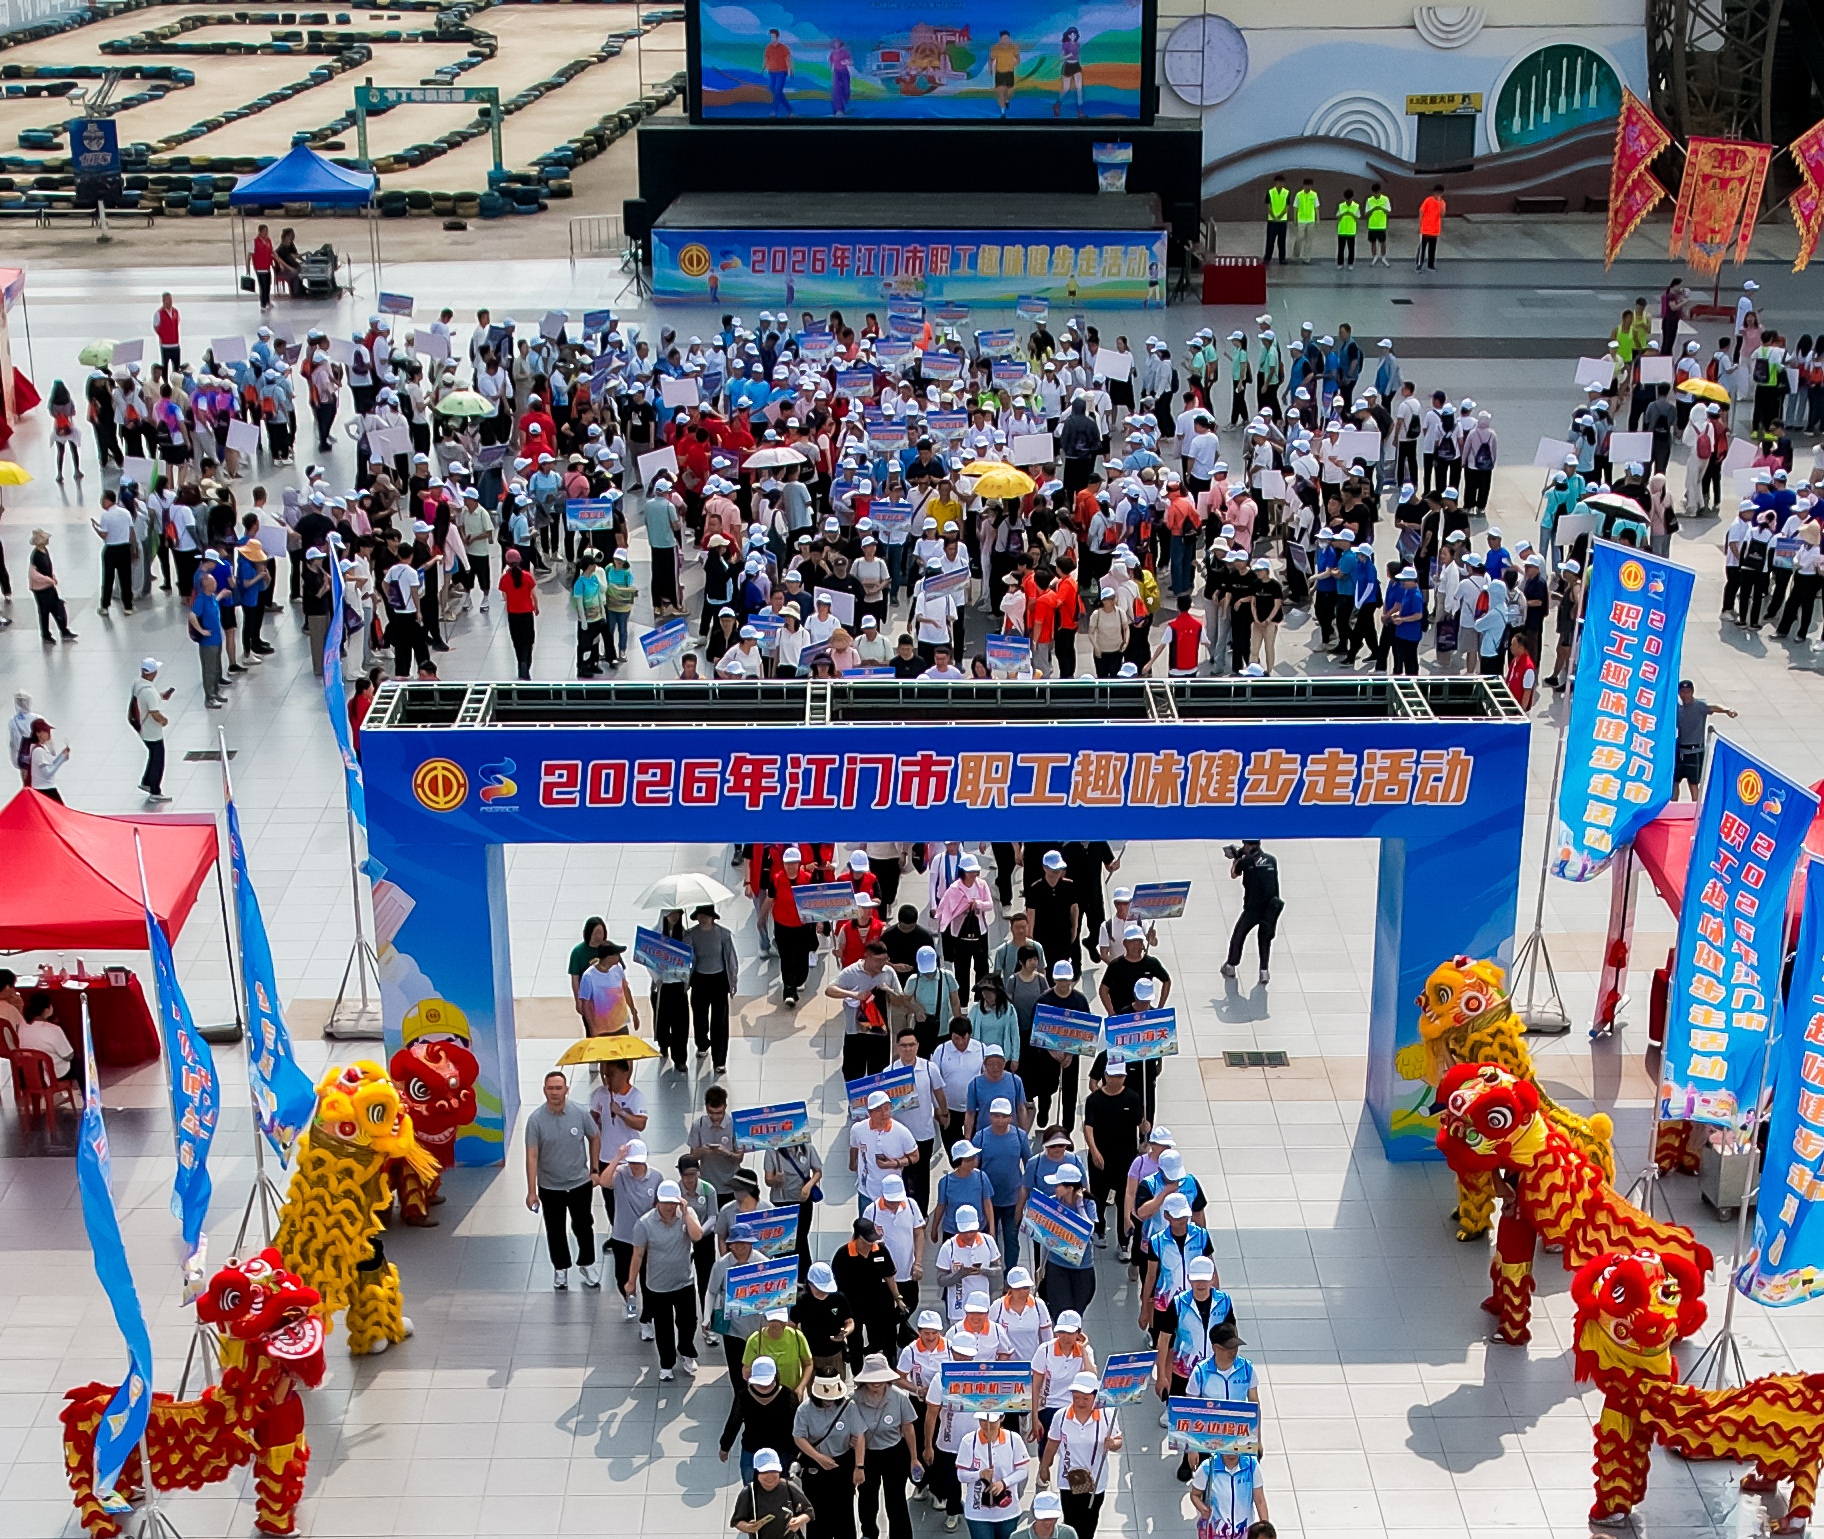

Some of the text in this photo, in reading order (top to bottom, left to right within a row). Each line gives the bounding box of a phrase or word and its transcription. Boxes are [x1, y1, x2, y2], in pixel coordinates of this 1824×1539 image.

[750, 243, 1150, 278] 2026年江门市职工趣味健步走活动
[539, 752, 1473, 811] 2026年江门市职工趣味健步走活动
[1583, 600, 1644, 852] 职工趣味健步走活动
[1623, 609, 1666, 804] 2026年江门市
[1687, 810, 1751, 1081] 职工趣味健步走活动
[1730, 831, 1776, 1032] 2026年江门市
